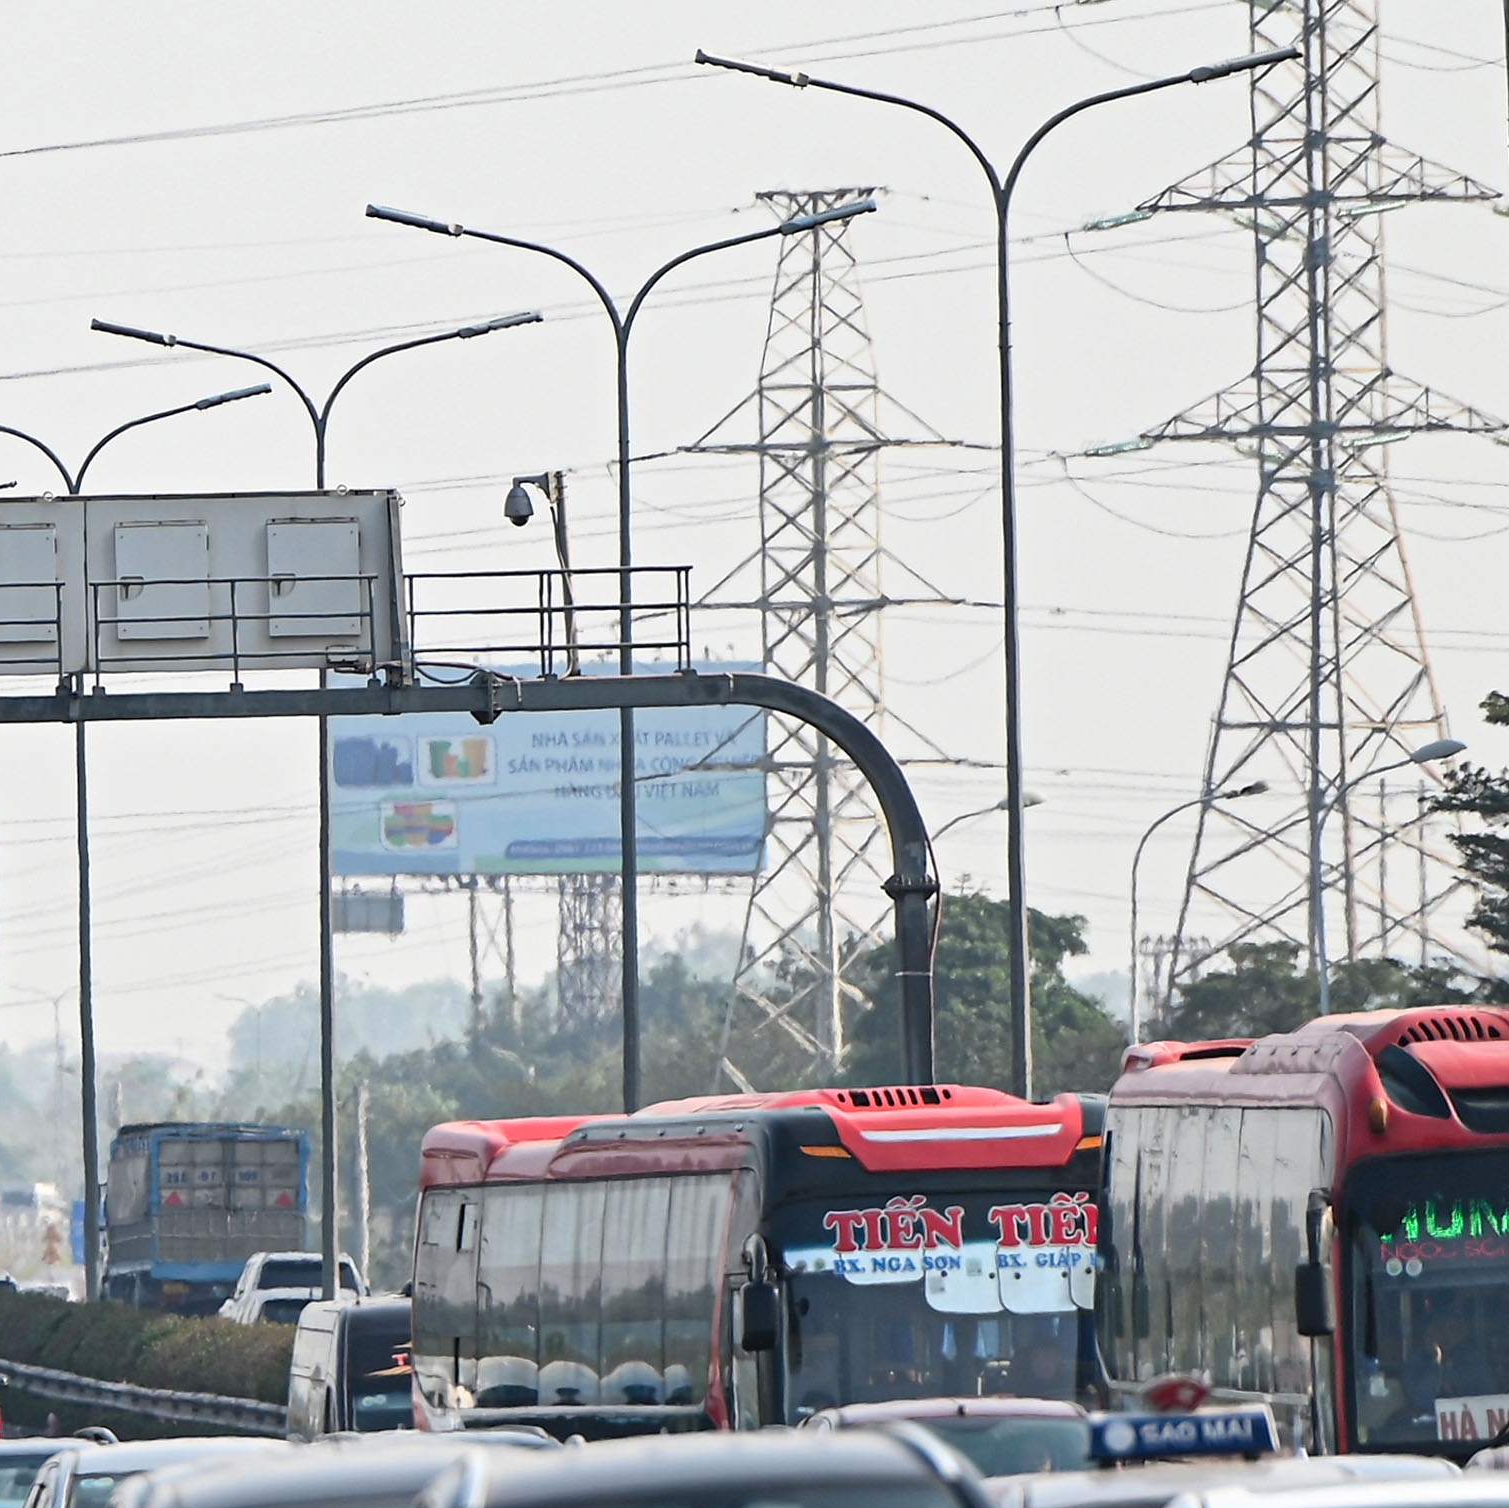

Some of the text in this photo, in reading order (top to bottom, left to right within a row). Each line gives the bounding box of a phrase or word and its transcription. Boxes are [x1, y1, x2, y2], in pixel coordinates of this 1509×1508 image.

[655, 727, 710, 746] PALLET
[683, 782, 721, 799] NAM
[824, 1194, 965, 1253] TIẾN
[871, 1257, 917, 1273] NGA
[1440, 1403, 1509, 1440] HÀ N
